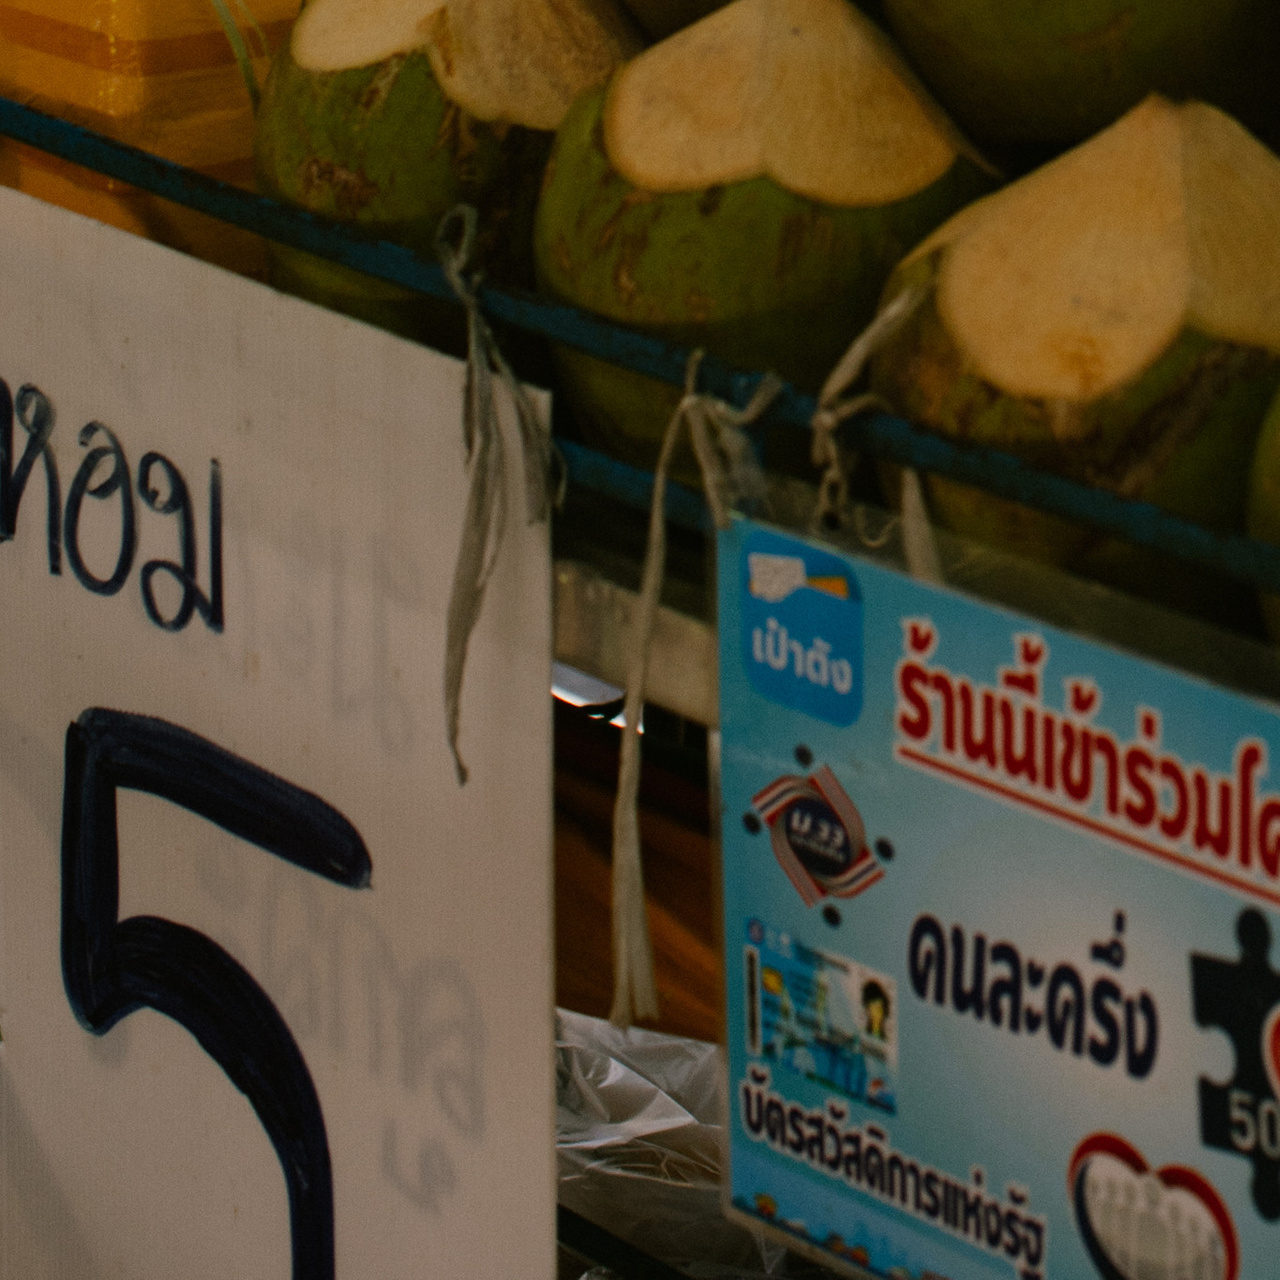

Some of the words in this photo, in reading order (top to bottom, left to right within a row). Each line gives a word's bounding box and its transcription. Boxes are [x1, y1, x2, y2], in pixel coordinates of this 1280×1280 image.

[752, 616, 853, 695] เป๋าตัง
[60, 706, 373, 1280] 5
[907, 910, 1160, 1080] คนละครึ่ง
[741, 1067, 1045, 1280] บัตรสวัสดิการแห่งรัฐ
